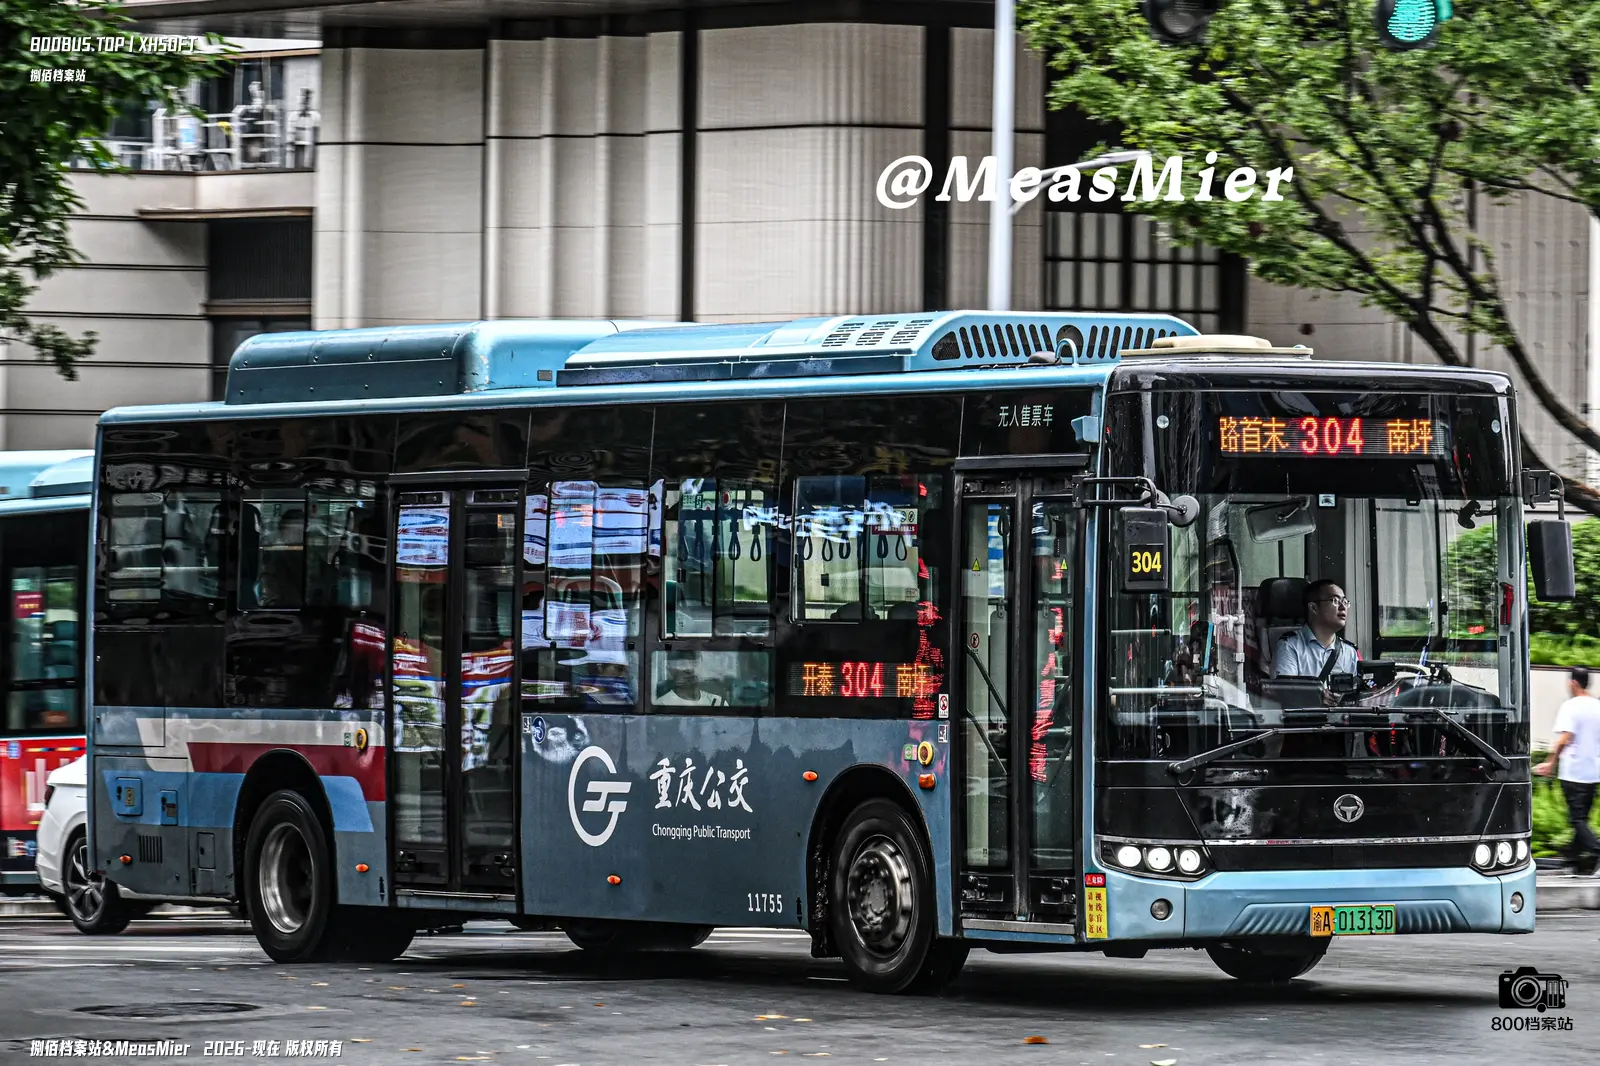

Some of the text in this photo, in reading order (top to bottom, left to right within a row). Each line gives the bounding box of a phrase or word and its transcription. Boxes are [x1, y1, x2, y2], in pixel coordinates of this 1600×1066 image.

[998, 404, 1053, 427] 无人售票车
[1219, 416, 1433, 455] 路首末 304 南坪
[1132, 551, 1162, 573] 304
[802, 662, 836, 697] 开泰
[840, 662, 885, 697] 304
[649, 757, 754, 813] 重庆公交
[652, 823, 751, 842] Chongqing Public Transport
[748, 892, 783, 914] 11755
